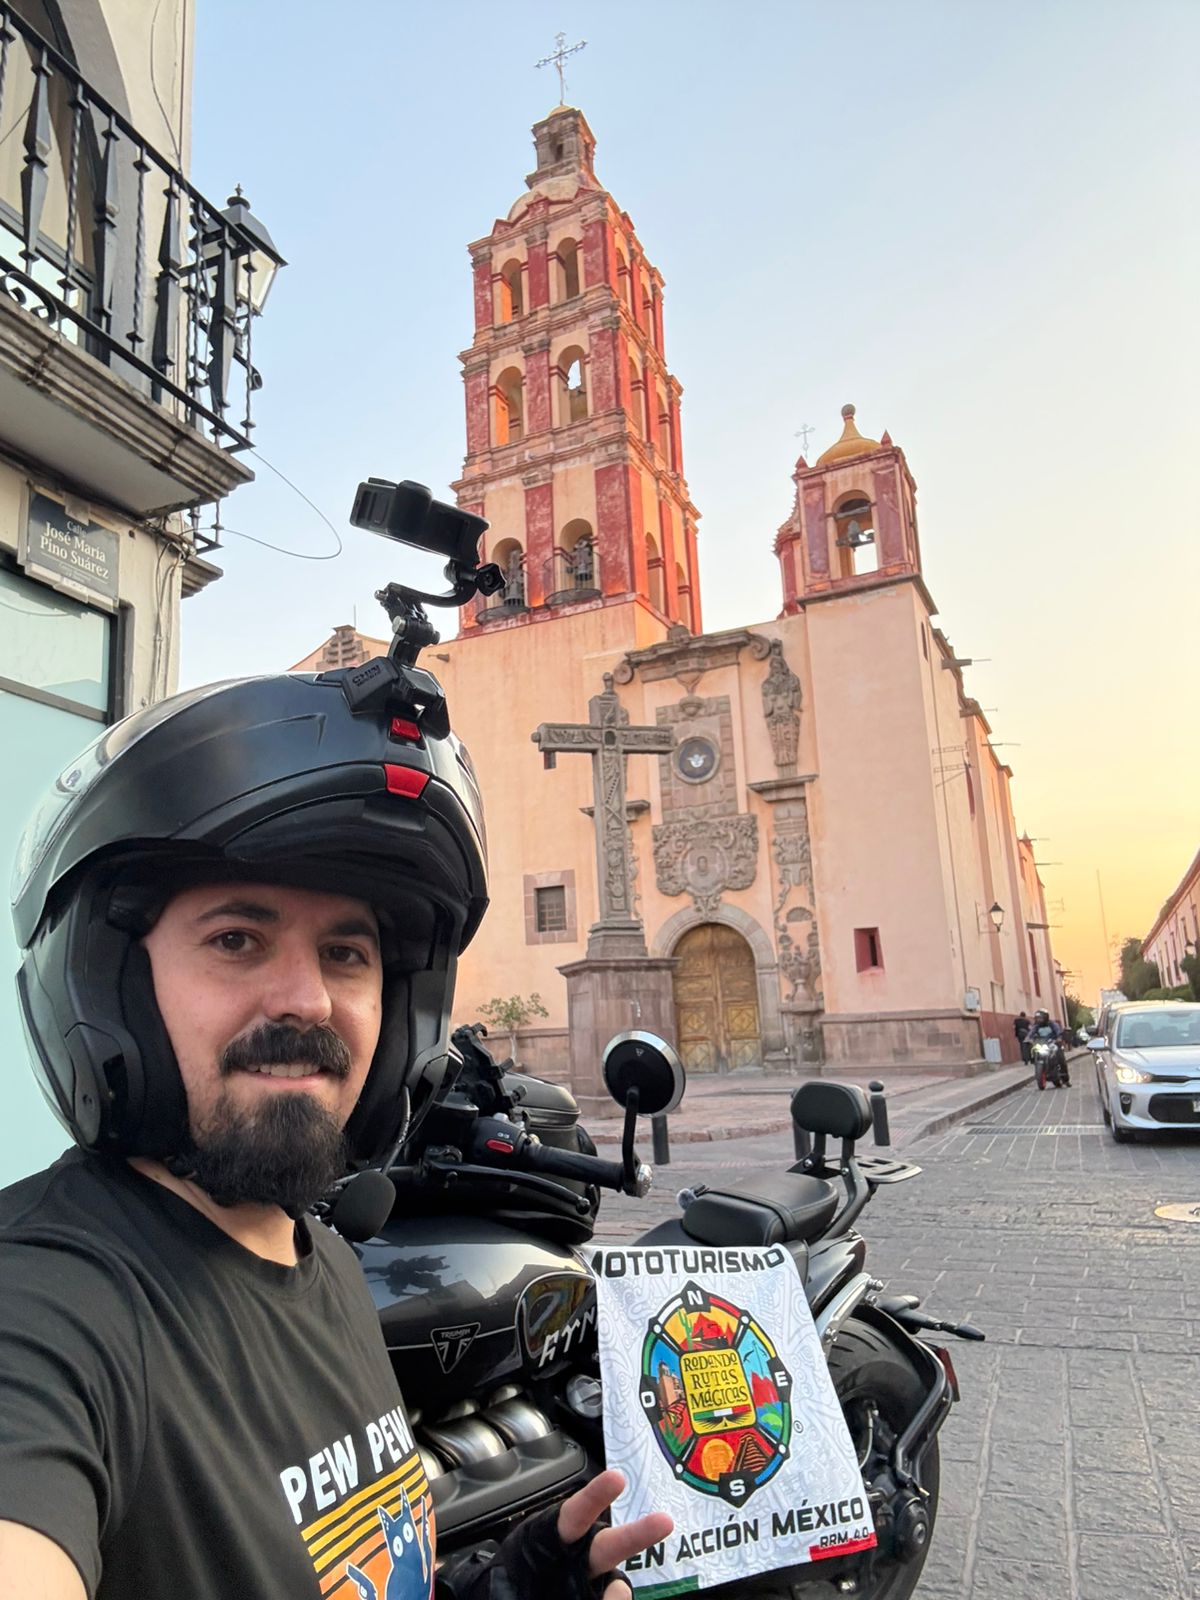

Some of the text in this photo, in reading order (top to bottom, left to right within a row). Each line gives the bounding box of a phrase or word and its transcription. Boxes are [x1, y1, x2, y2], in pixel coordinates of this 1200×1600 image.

[44, 521, 106, 563] José María
[40, 535, 68, 560] Pino
[70, 550, 110, 580] Suárez
[686, 1289, 704, 1306] N
[440, 1328, 471, 1340] TRIUMPH
[774, 1371, 789, 1387] E
[279, 1405, 415, 1526] PEW PEW
[729, 1479, 746, 1496] S
[676, 1514, 759, 1562] ACCIÓN
[772, 1497, 864, 1537] MÉXICO
[820, 1531, 849, 1548] RRM
